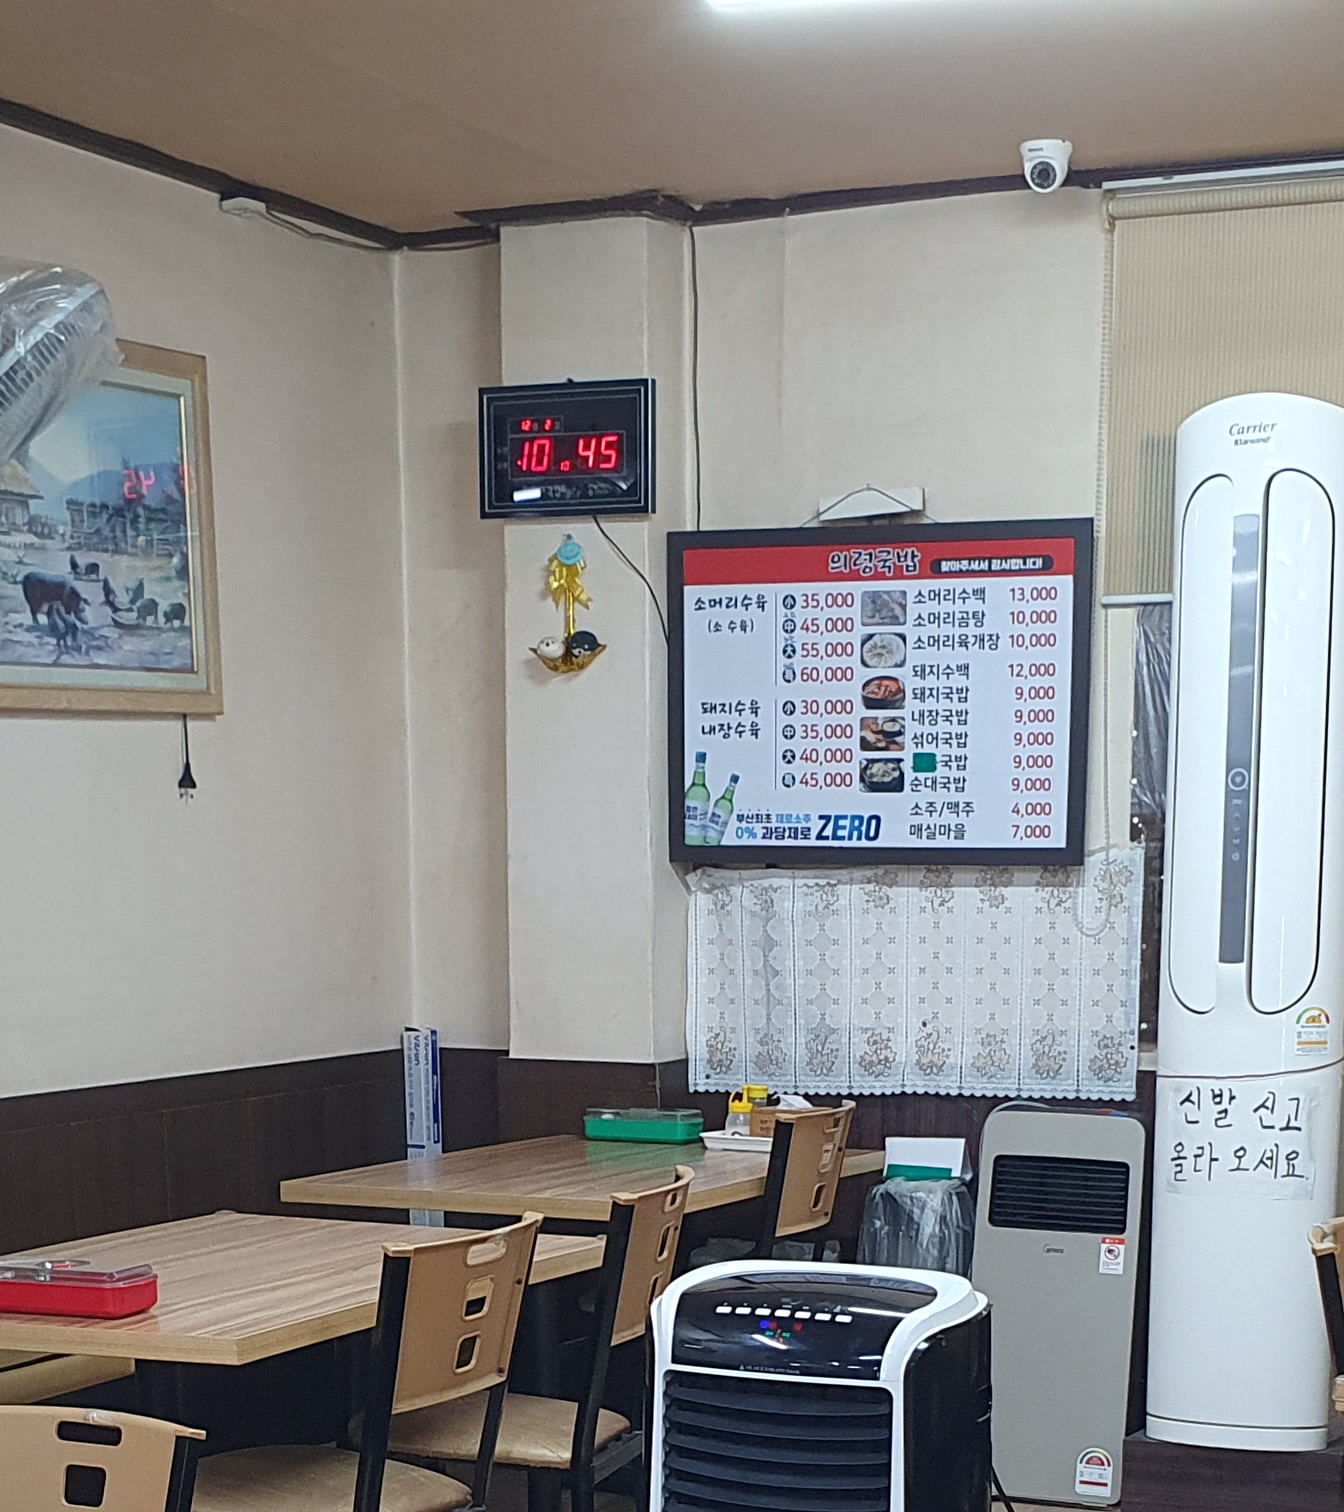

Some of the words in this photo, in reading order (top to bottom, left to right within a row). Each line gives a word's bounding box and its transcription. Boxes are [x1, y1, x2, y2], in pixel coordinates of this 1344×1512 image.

[520, 418, 533, 431] 12
[543, 418, 553, 431] 2
[1228, 421, 1278, 436] Carrier
[521, 438, 551, 472] 10
[577, 434, 619, 469] 45
[829, 548, 921, 576] 의령국밥
[693, 593, 768, 612] 소머리수육
[800, 592, 855, 612] 35,000
[912, 587, 986, 605] 소머리수백
[1009, 586, 1058, 604] 13,000
[800, 617, 854, 636] 45,000
[912, 610, 986, 628] 소머리곰탕
[1009, 610, 1057, 627] 10,000
[912, 632, 1001, 651] 소머리육개장
[1009, 633, 1057, 650] 10,000
[800, 642, 854, 660] 55,000
[800, 666, 854, 685] 60,000
[912, 662, 970, 681] 돼지수백
[1008, 663, 1056, 680] 12,000
[911, 686, 970, 703] 돼지국밥
[1015, 686, 1056, 702] 9,000
[701, 699, 761, 717] 돼지수육
[800, 700, 854, 718] 30,000
[911, 708, 969, 727] 내장국밥
[1014, 709, 1055, 726] 9,000
[701, 721, 761, 740] 내장수육
[800, 723, 854, 742] 35,000
[1013, 732, 1054, 748] 9,000
[799, 748, 854, 766] 40,000
[1013, 755, 1054, 771] 9,000
[799, 772, 853, 790] 45,000
[909, 776, 967, 793] 순대국밥
[1011, 778, 1052, 794] 9,000
[909, 800, 976, 818] 소주/맥주
[1011, 802, 1052, 818] 4,000
[736, 813, 773, 824] 부산최초
[735, 826, 758, 840] 0%
[760, 826, 812, 840] 과당제로
[815, 814, 882, 842] ZERO
[909, 823, 967, 840] 매실마을
[1011, 825, 1051, 840] 7,000
[1179, 1086, 1237, 1128] 신발
[1252, 1090, 1303, 1132] 신고
[1170, 1141, 1219, 1182] 올라
